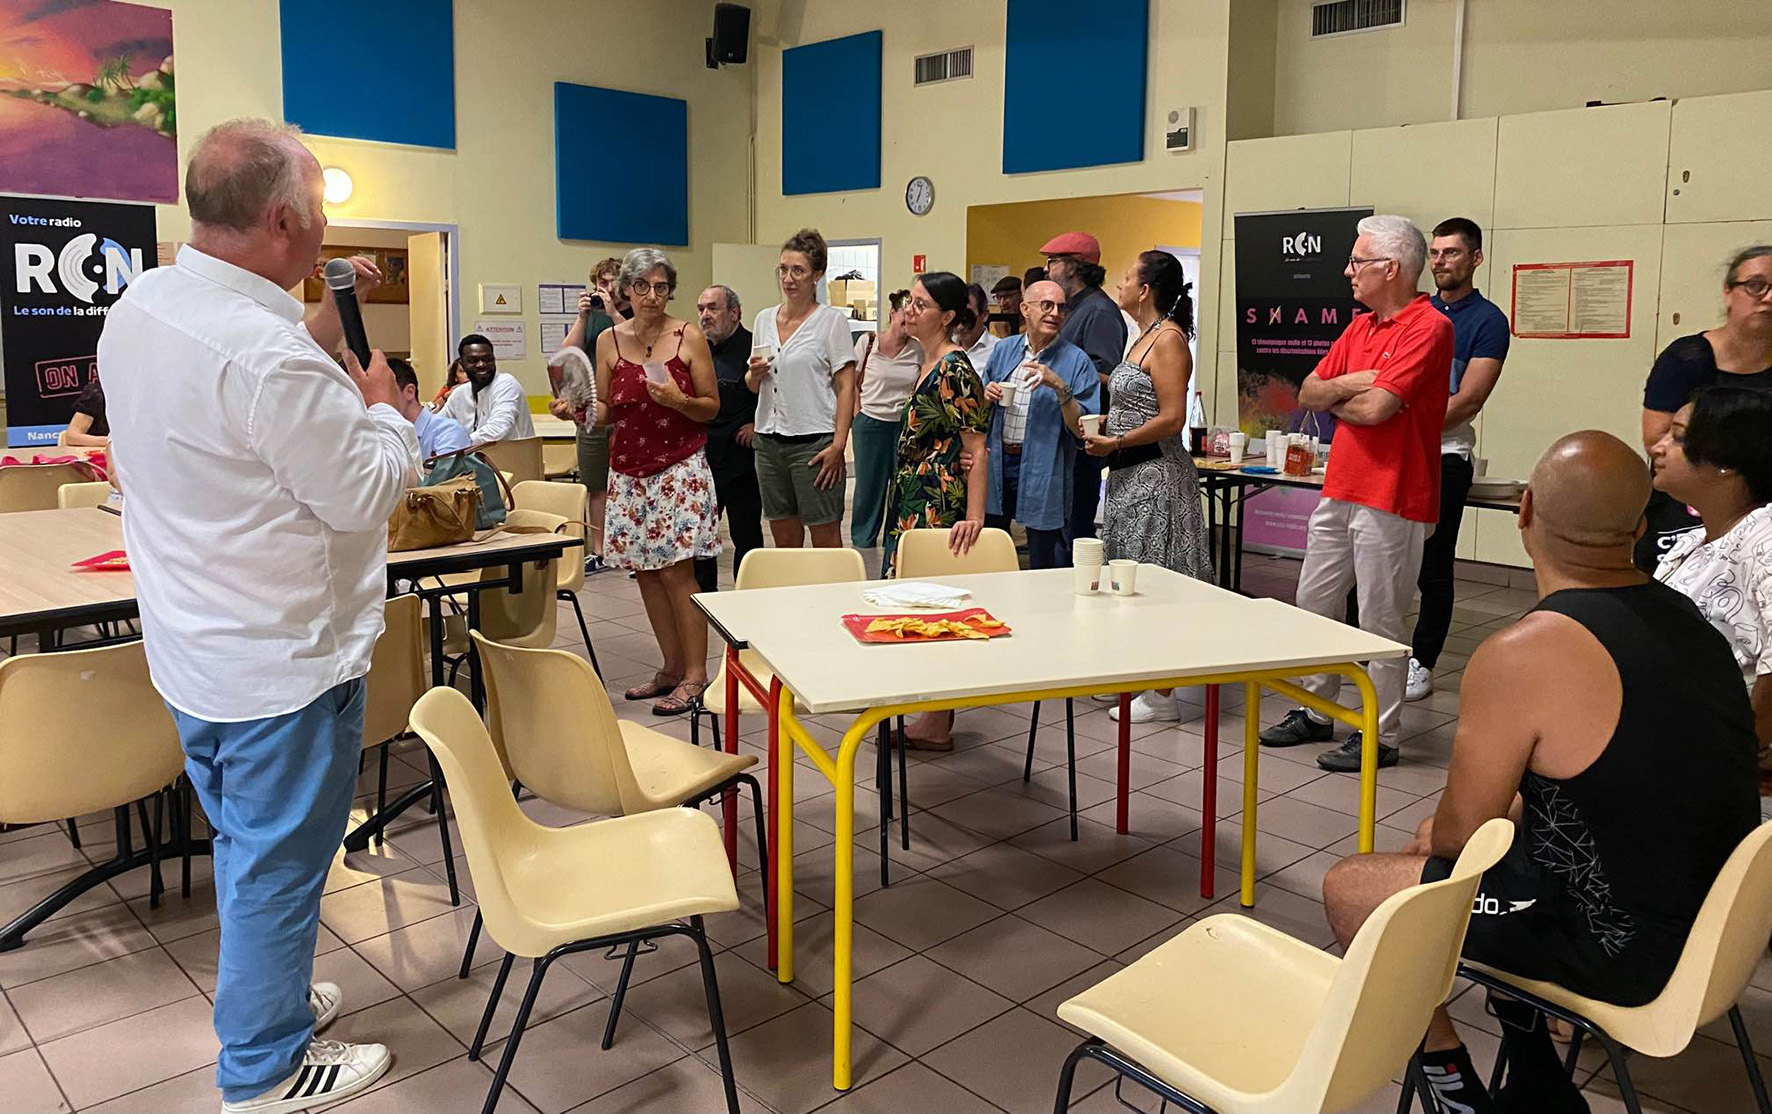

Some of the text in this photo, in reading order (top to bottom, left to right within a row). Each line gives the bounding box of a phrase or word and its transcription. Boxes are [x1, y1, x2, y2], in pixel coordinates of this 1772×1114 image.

[9, 214, 82, 228] Votre radio
[1282, 231, 1321, 256] RCN
[14, 232, 143, 304] RCN
[13, 306, 108, 316] Le son de la diff
[45, 365, 79, 390] ON
[27, 431, 59, 441] Nanc
